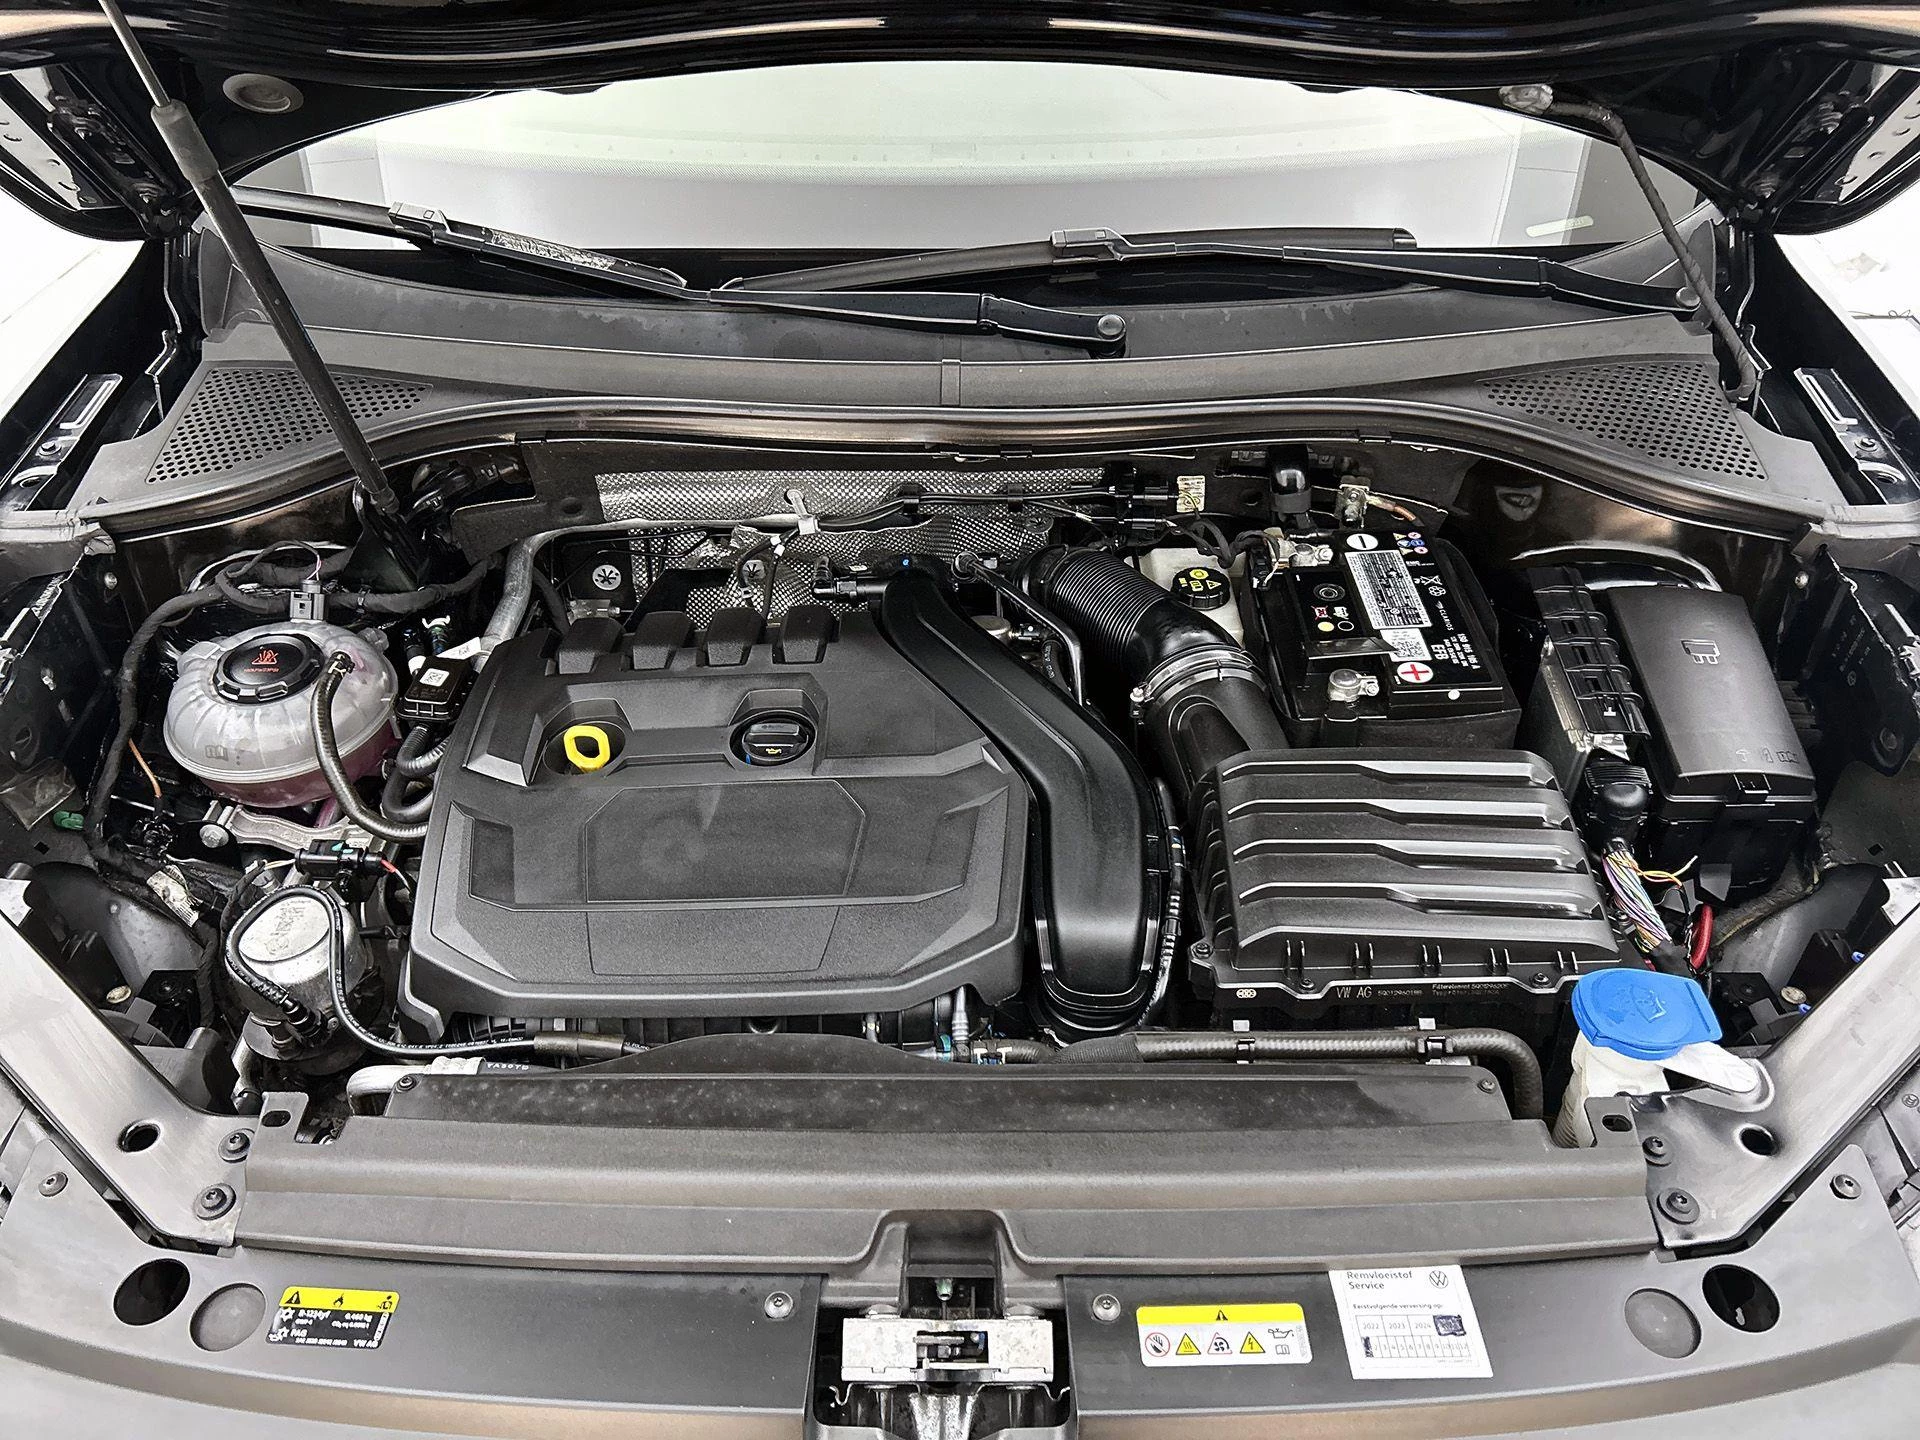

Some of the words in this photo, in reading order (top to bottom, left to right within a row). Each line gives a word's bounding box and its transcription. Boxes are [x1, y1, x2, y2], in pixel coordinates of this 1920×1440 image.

[1431, 644, 1450, 660] EFB
[1336, 987, 1351, 998] VW
[1356, 986, 1372, 998] AG
[1346, 1271, 1413, 1280] Remvloeistof
[1348, 1282, 1385, 1290] Service
[353, 1338, 367, 1348] VW
